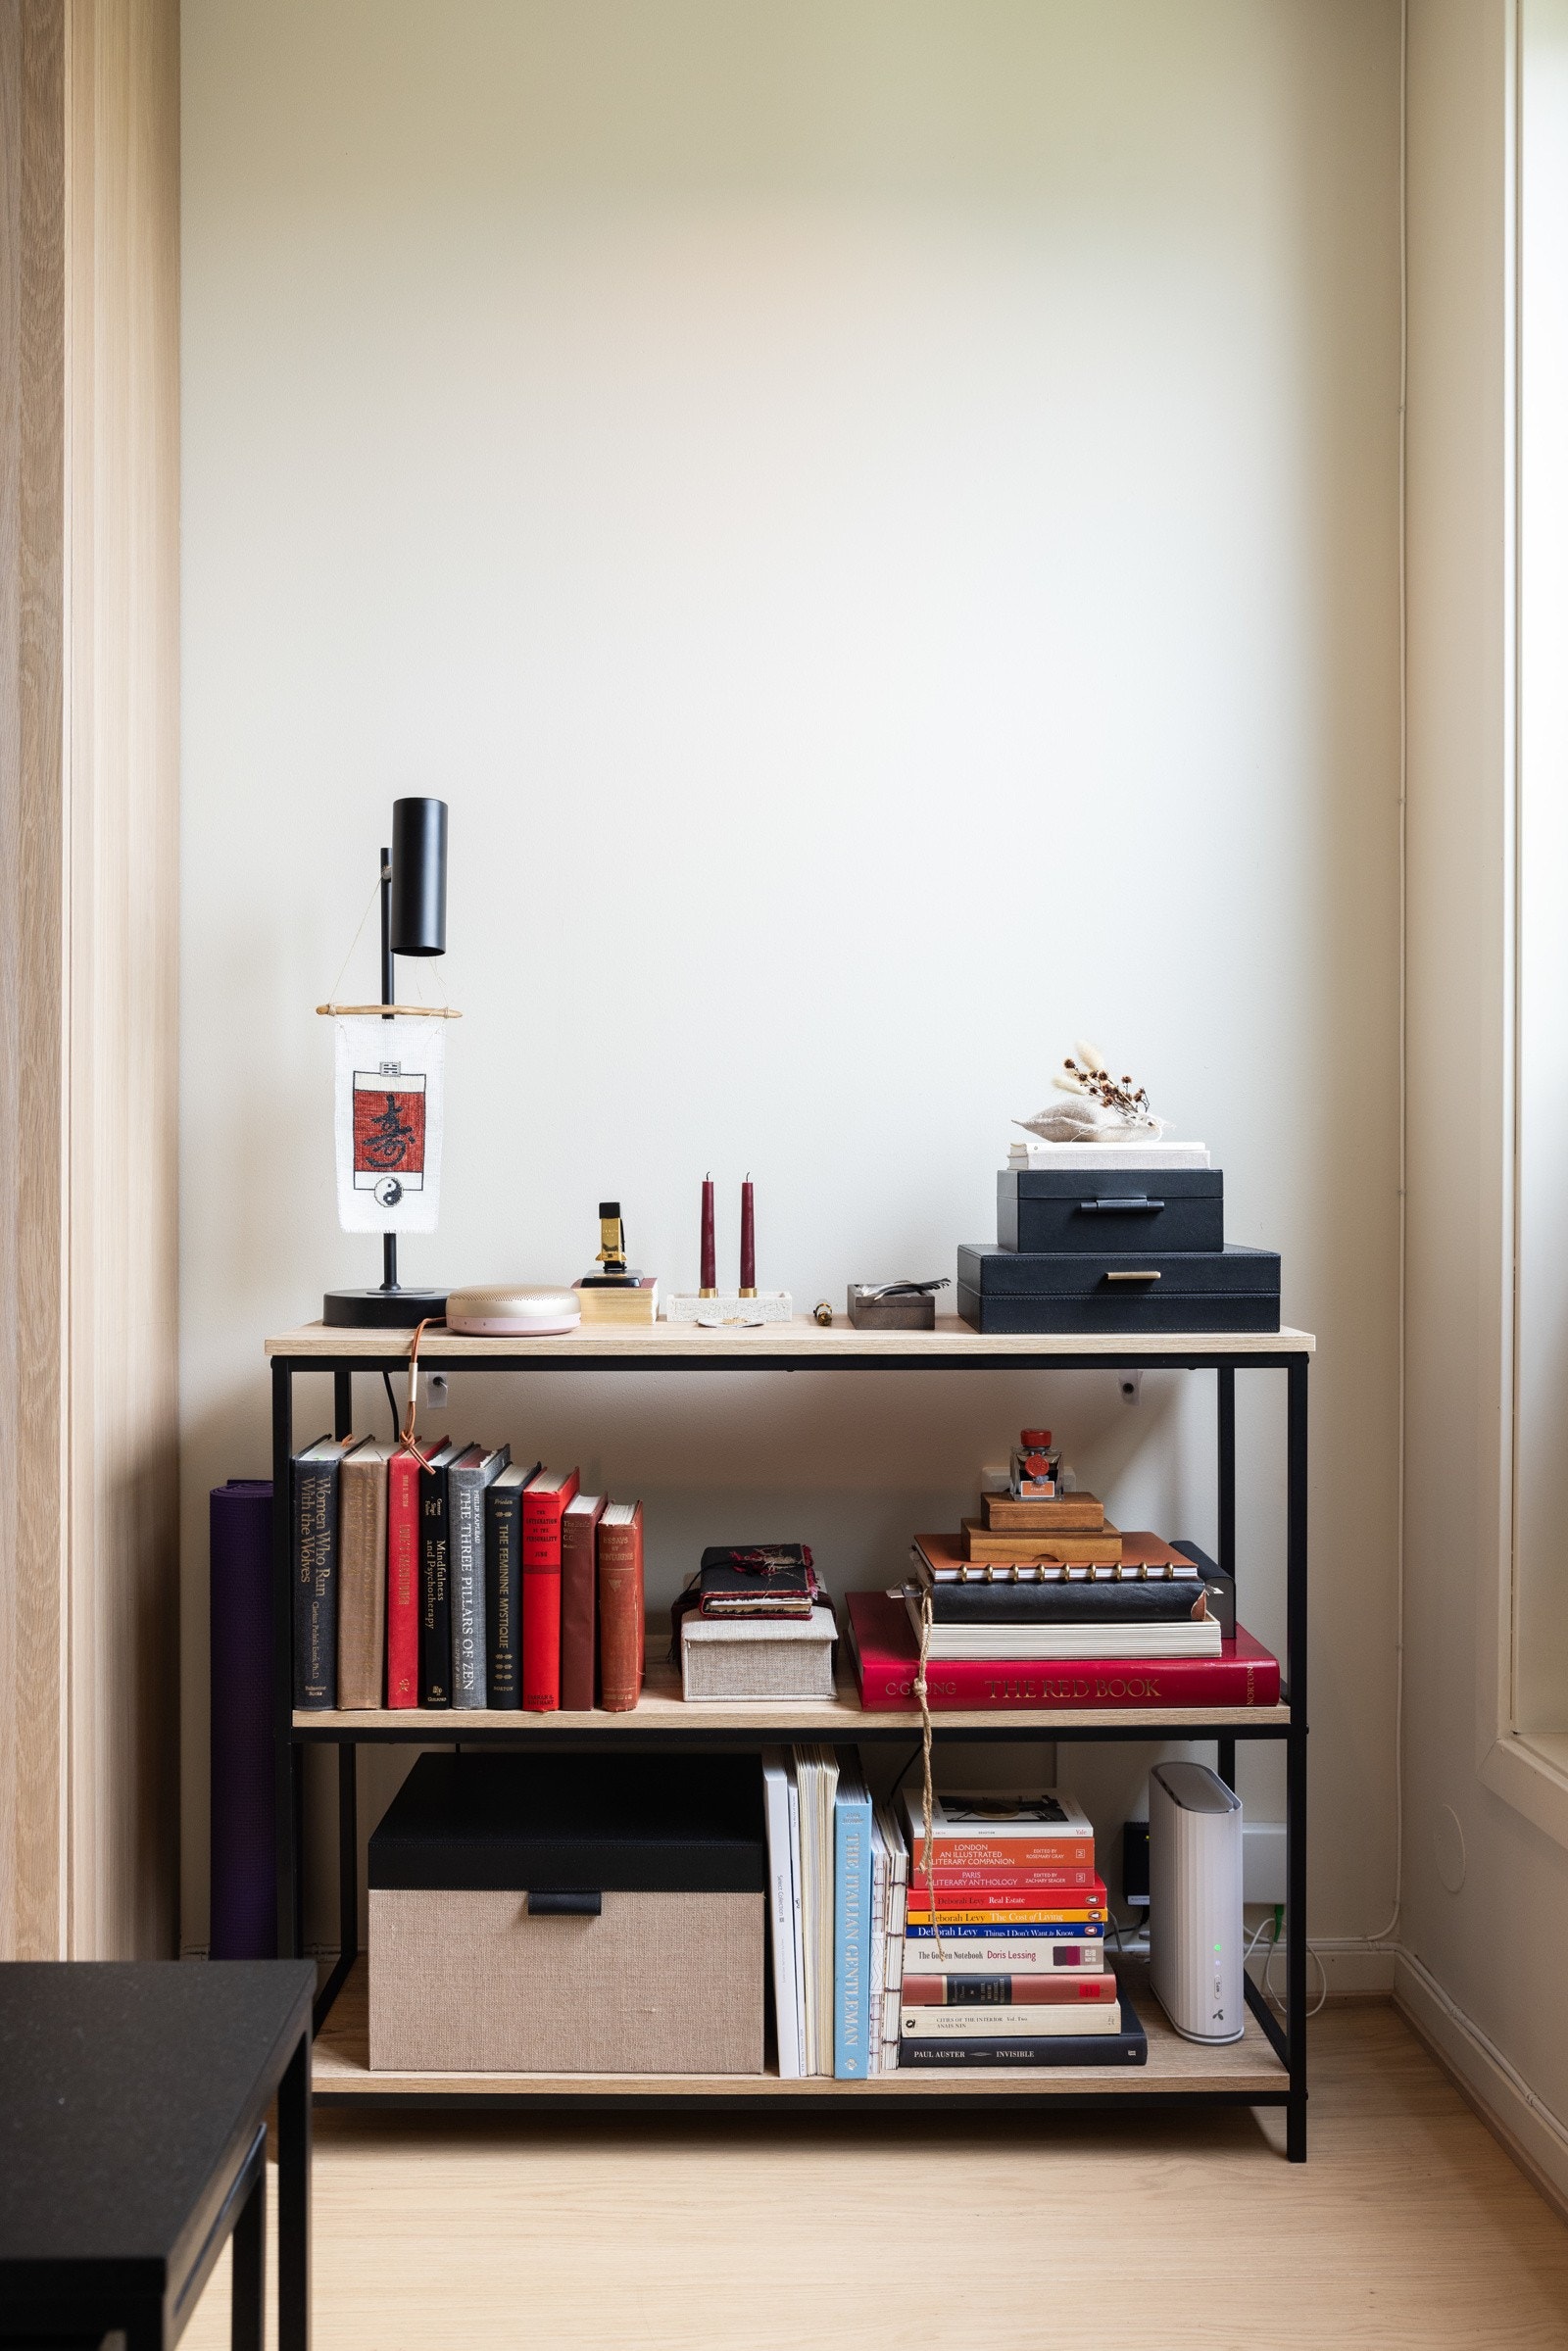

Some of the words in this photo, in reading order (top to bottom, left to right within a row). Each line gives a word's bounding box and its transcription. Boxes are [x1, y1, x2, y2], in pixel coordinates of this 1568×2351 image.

[301, 1476, 316, 1510] With
[316, 1476, 331, 1529] Women
[460, 1489, 471, 1519] THE
[302, 1513, 315, 1534] the
[499, 1524, 509, 1544] THE
[301, 1536, 316, 1583] Wolves
[316, 1530, 331, 1565] Who
[426, 1540, 436, 1558] and
[461, 1522, 471, 1572] THREE
[316, 1568, 330, 1596] Run
[436, 1540, 447, 1600] Mindfulness
[499, 1547, 509, 1595] FEMININE
[424, 1560, 437, 1630] Psychotherapy
[461, 1576, 472, 1635] PILLARS
[498, 1597, 509, 1649] MYSTIQUE
[463, 1639, 473, 1657] OF
[463, 1662, 474, 1690] ZEN
[985, 1679, 1037, 1698] THE
[1042, 1679, 1090, 1698] RED
[1095, 1678, 1162, 1697] BOOK
[846, 1832, 860, 1868] THE
[845, 1872, 860, 1939] ITALIAN
[965, 1913, 986, 1924] Levy
[1029, 1912, 1036, 1922] of
[1037, 1912, 1064, 1923] Living
[957, 1927, 978, 1937] Levy
[983, 1929, 1006, 1937] Things
[1008, 1951, 1037, 1962] Lessing
[844, 1943, 859, 2046] GENTLEMAN
